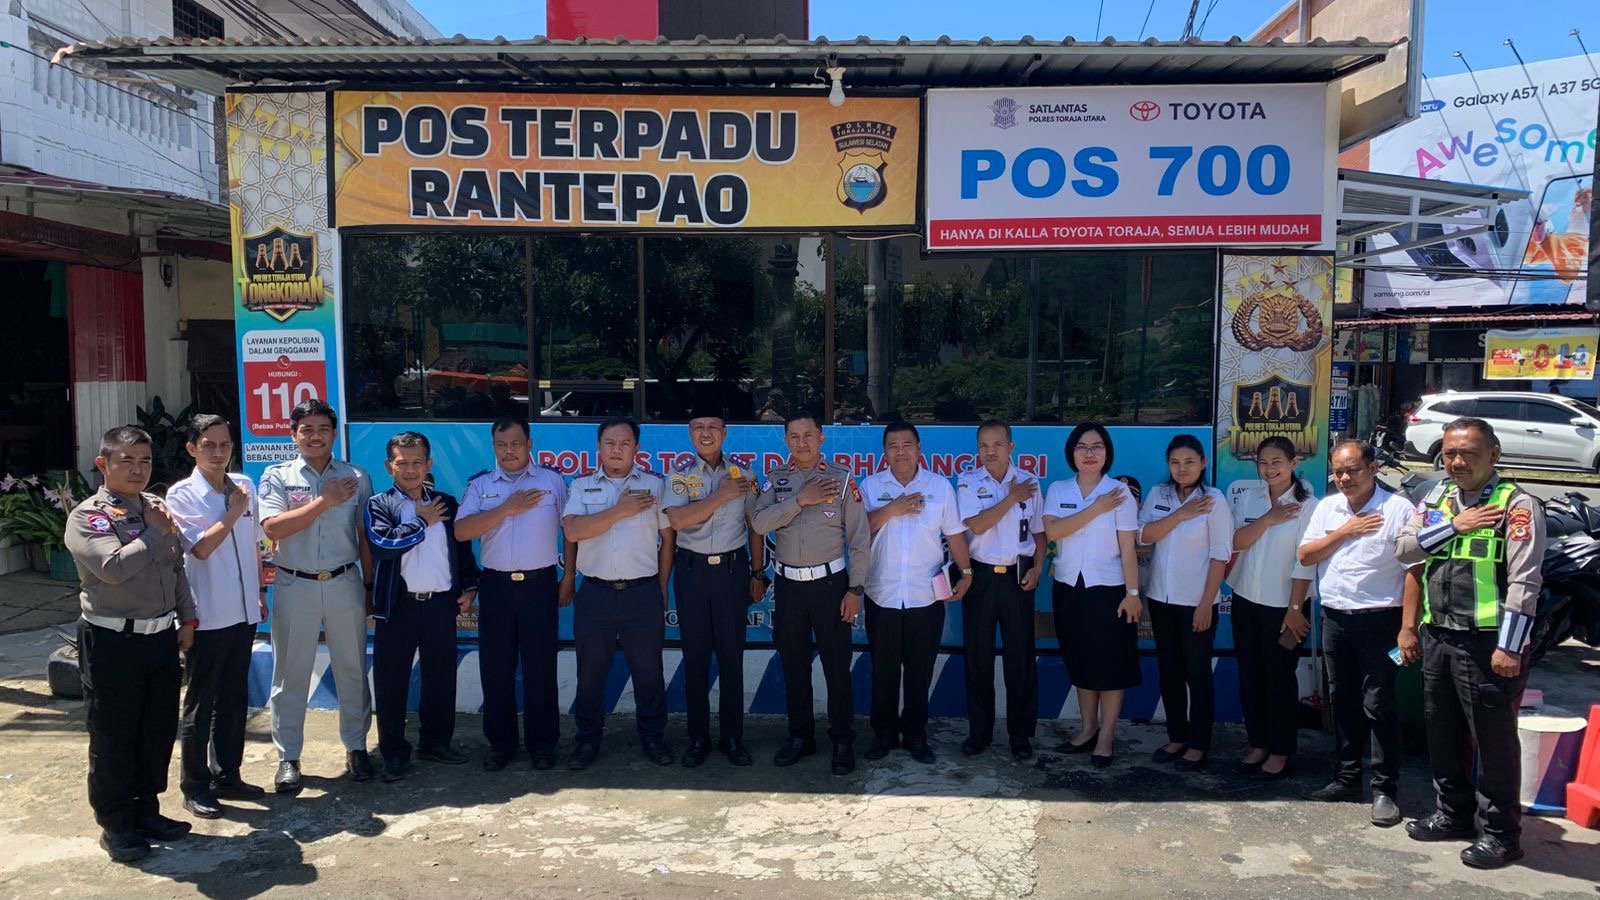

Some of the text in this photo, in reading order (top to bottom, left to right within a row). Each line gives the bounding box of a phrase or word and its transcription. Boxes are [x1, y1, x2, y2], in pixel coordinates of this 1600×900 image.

[1453, 77, 1600, 108] Galaxy A57 A37 5G
[1029, 103, 1088, 114] SATLANTAS
[1169, 102, 1267, 121] TOYOTA
[1083, 114, 1106, 122] UTARA
[836, 122, 892, 131] POLRES
[362, 104, 798, 165] POS TERPADU
[837, 128, 891, 137] TORAJA UTARA
[838, 139, 889, 149] SULAWESI SELATAN
[960, 144, 1291, 199] POS 700
[408, 166, 749, 227] RANTEPAO
[940, 224, 1309, 240] HANYA DI KALLA TOYOTA TORAJA, SEMUA LEBIH MUDAH
[238, 275, 324, 305] TONGKONAN
[246, 336, 320, 345] LAYANAN KEPOLISIAN
[248, 346, 319, 355] DALAM GENGGAMAN
[252, 423, 274, 431] (Bebas
[245, 444, 283, 452] LAYANAN
[246, 453, 273, 462] BEBAS
